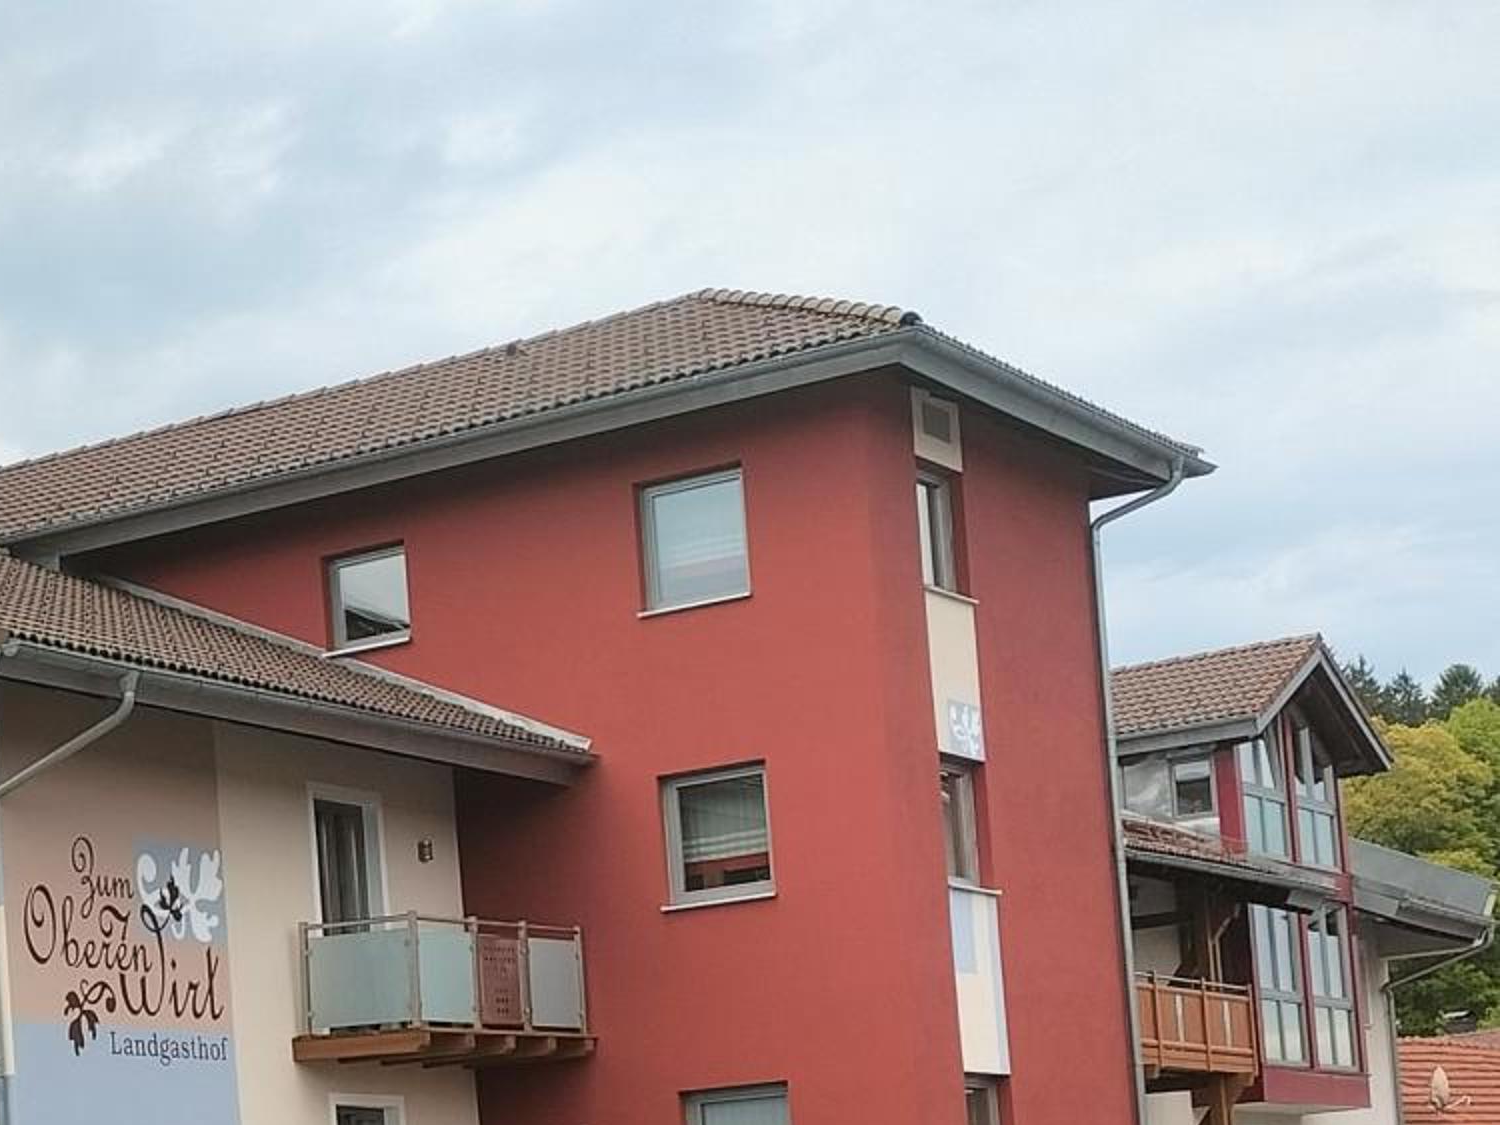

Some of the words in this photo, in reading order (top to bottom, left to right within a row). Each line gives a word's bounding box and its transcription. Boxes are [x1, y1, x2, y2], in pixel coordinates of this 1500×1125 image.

[71, 836, 134, 918] Zum
[23, 884, 152, 972] Oberen
[109, 1031, 229, 1066] Landgasthof
